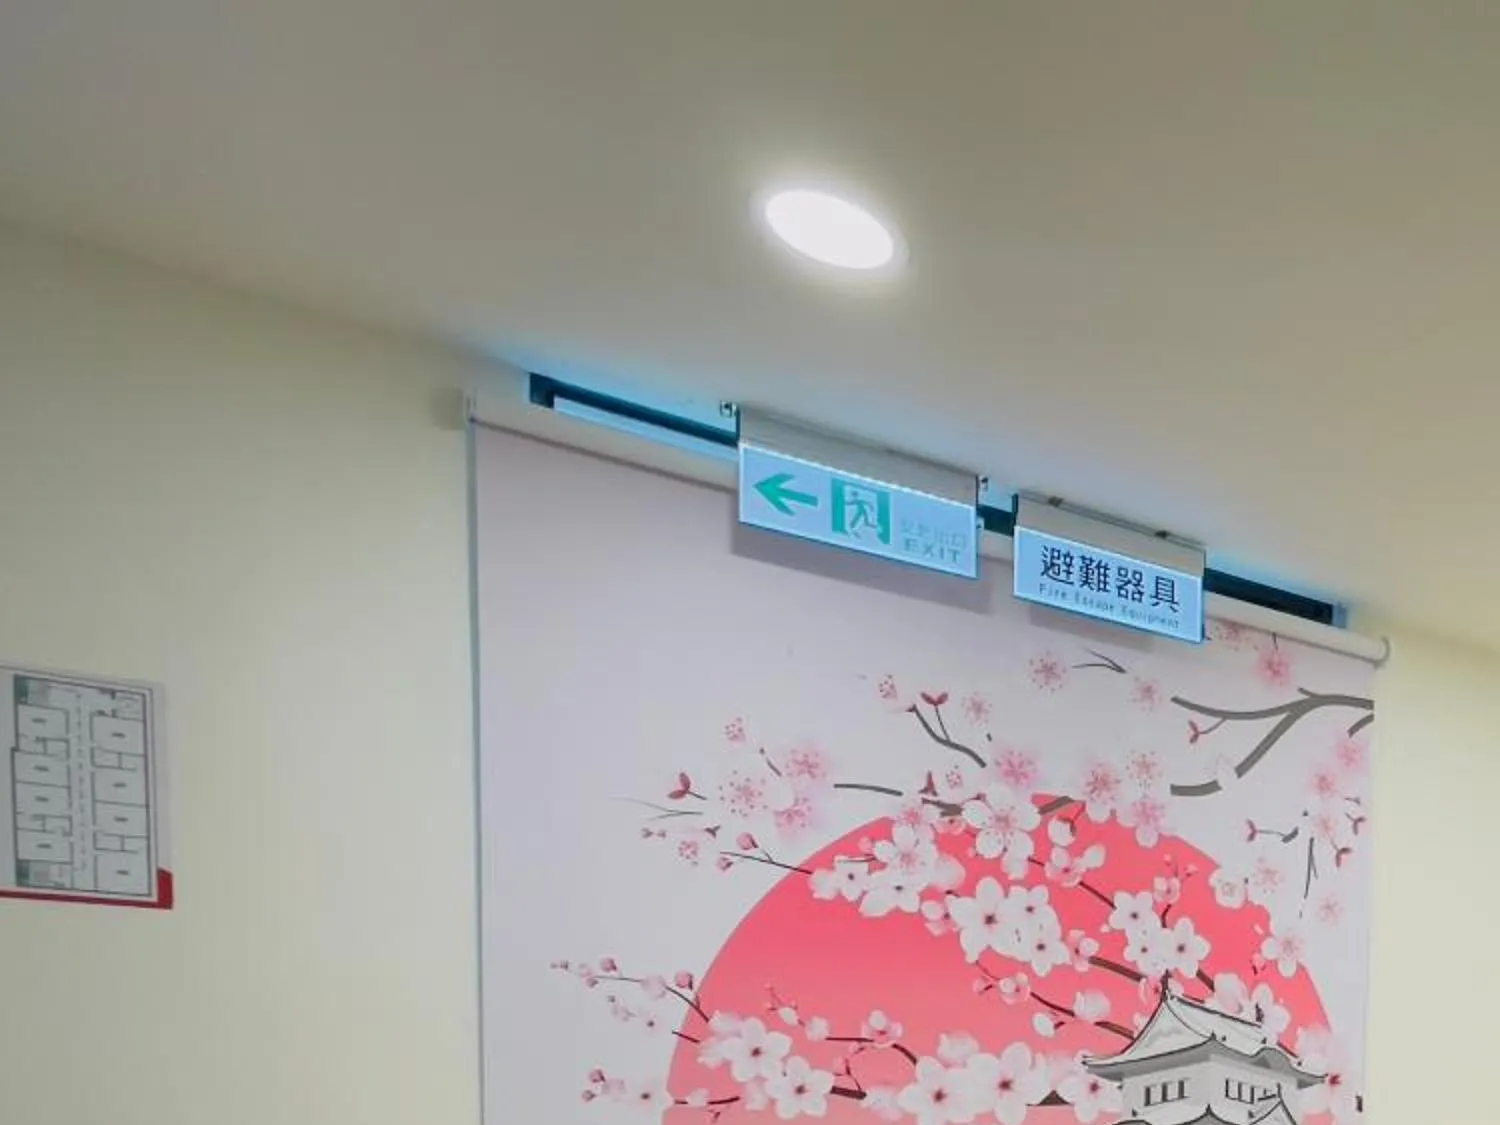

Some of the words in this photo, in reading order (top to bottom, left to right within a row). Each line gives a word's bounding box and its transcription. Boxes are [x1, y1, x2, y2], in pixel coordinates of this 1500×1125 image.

[904, 537, 961, 563] EXIT
[1039, 583, 1067, 599] Fire
[1040, 545, 1180, 613] 避難器具
